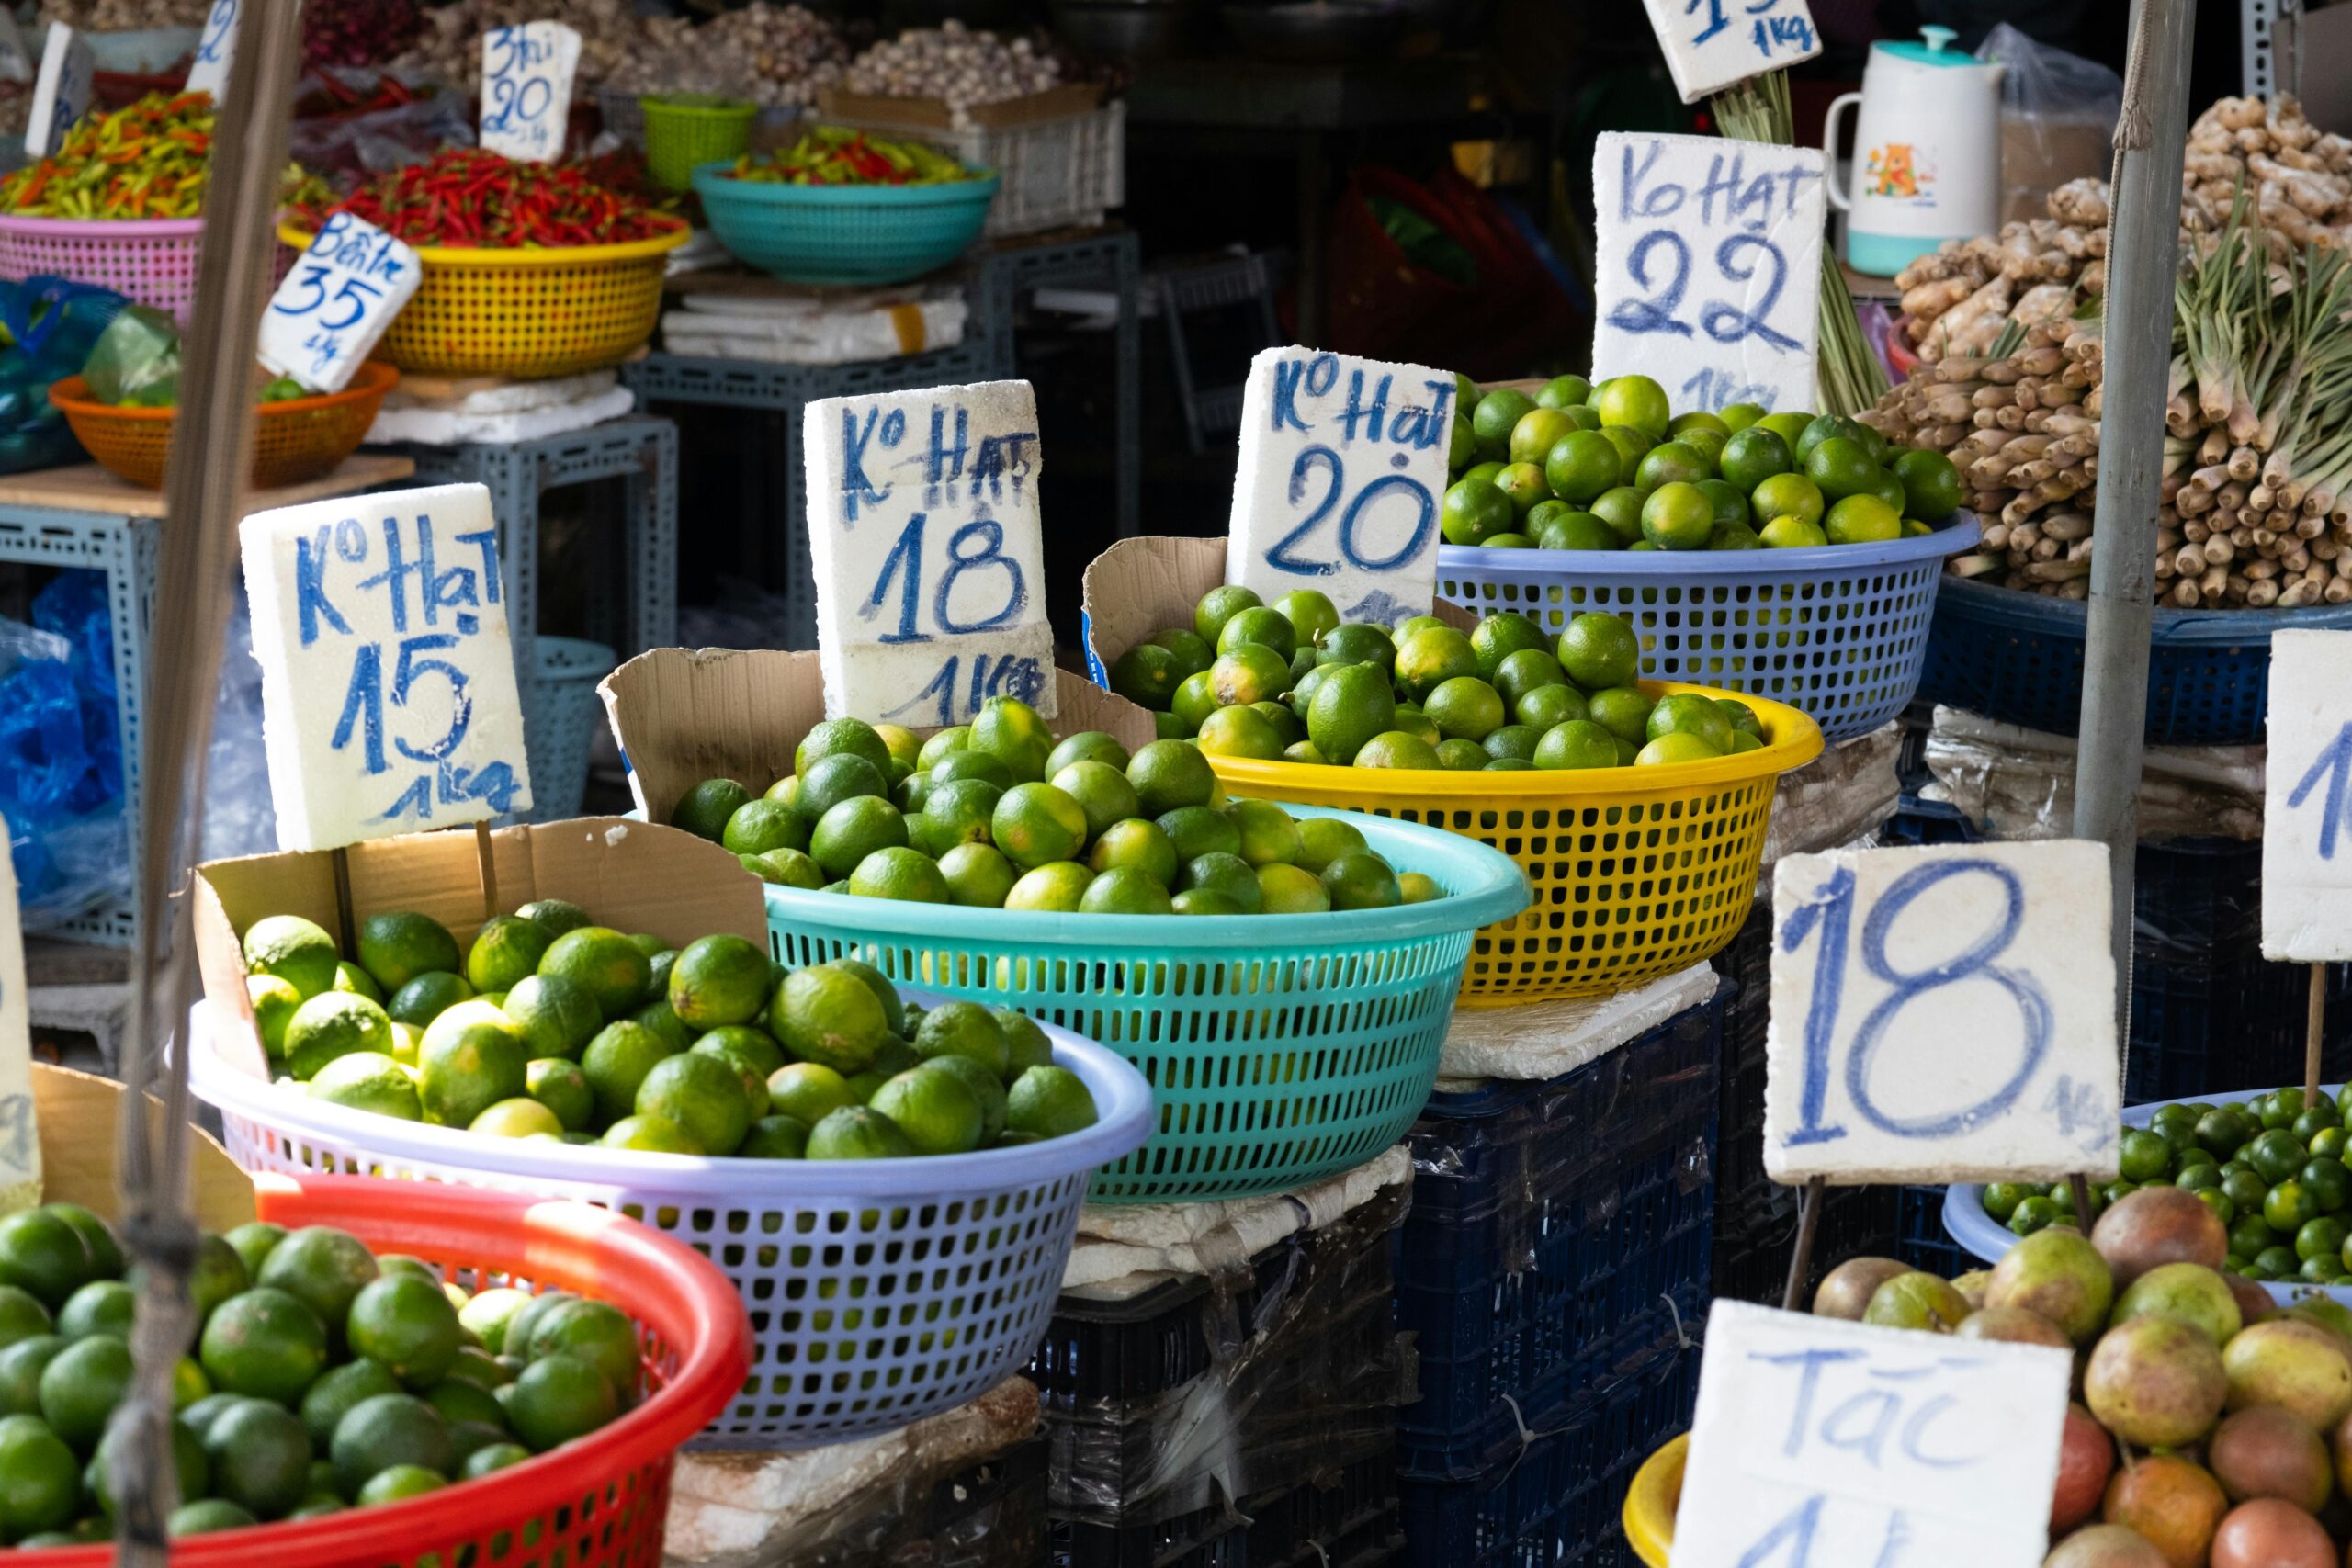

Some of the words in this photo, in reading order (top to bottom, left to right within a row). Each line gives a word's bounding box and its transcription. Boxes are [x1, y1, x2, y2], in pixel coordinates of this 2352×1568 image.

[481, 77, 551, 134] 20
[274, 265, 383, 329] 35
[1606, 229, 1808, 355] 22
[1261, 442, 1438, 577] 20
[857, 511, 1029, 644] 18
[331, 633, 473, 775] 15
[1780, 857, 2055, 1147] 18
